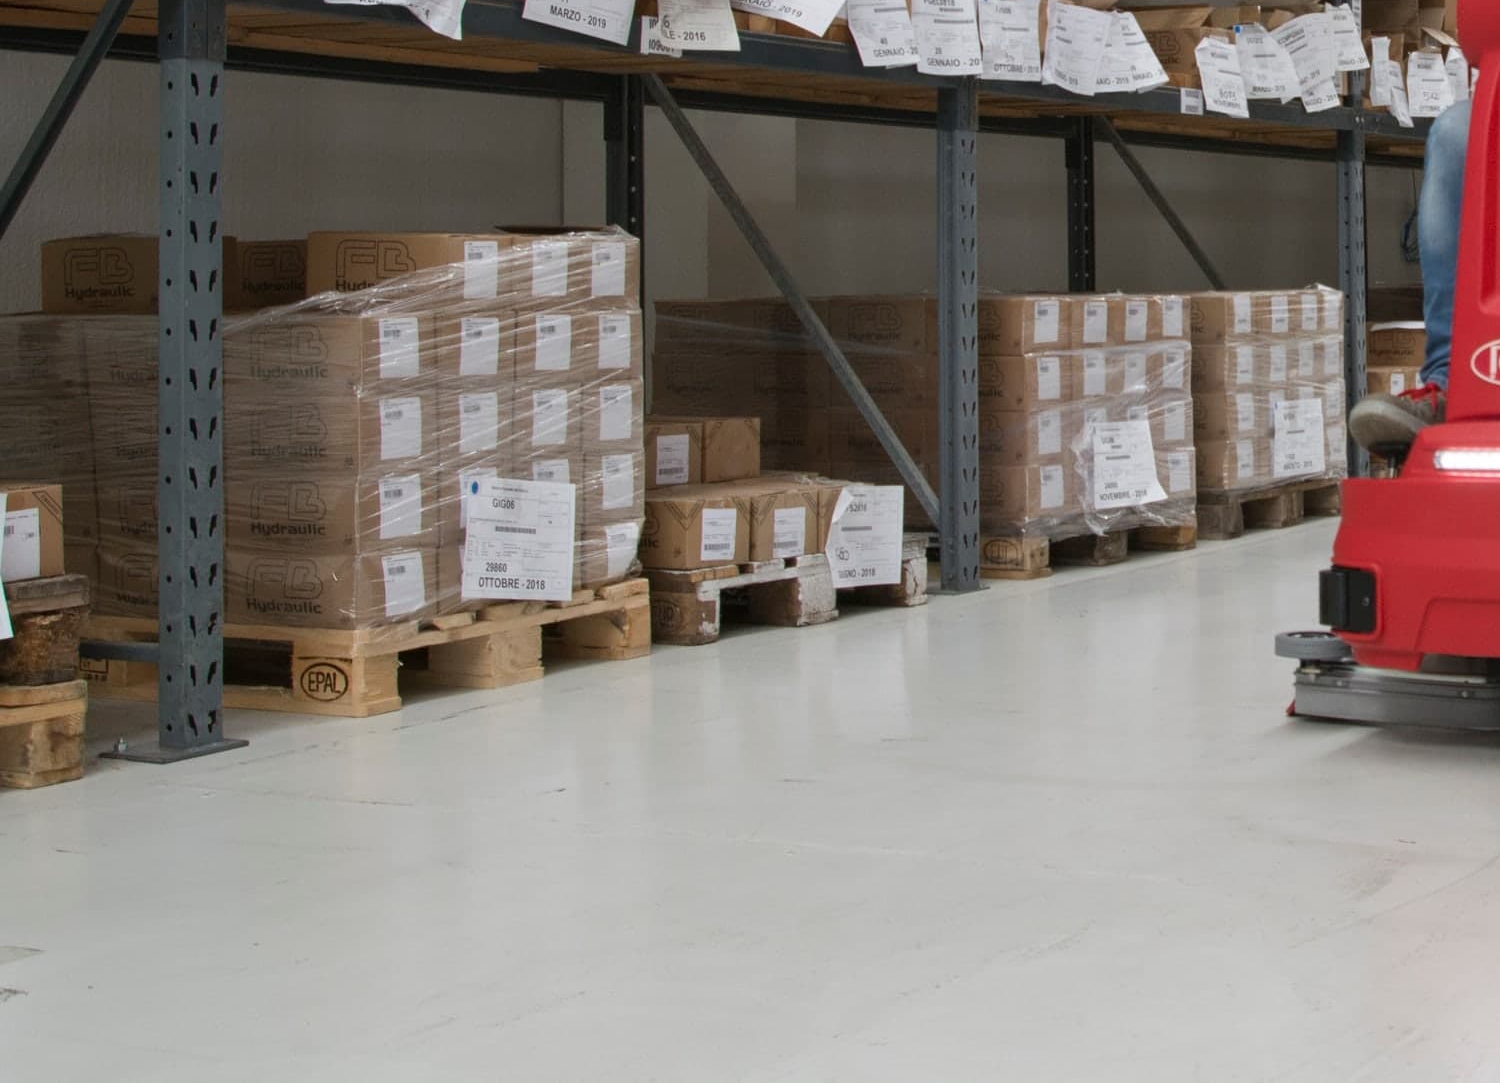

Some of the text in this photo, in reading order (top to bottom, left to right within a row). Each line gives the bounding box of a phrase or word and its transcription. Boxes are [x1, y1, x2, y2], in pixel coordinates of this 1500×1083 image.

[550, 5, 581, 23] MARZO
[588, 17, 607, 29] 2019
[779, 6, 802, 18] 2019
[873, 48, 905, 58] GENNAIO
[927, 57, 960, 67] GENNAIO
[65, 285, 134, 300] Hydraulic
[251, 365, 328, 380] Hydraulic
[251, 444, 327, 459] Hydraulic
[492, 498, 515, 509] GIG06
[251, 522, 326, 538] Hydraulic
[478, 577, 519, 589] OTTOBRE
[526, 579, 545, 590] 2018
[246, 598, 322, 615] Hydraulic
[308, 669, 341, 695] EPAL
